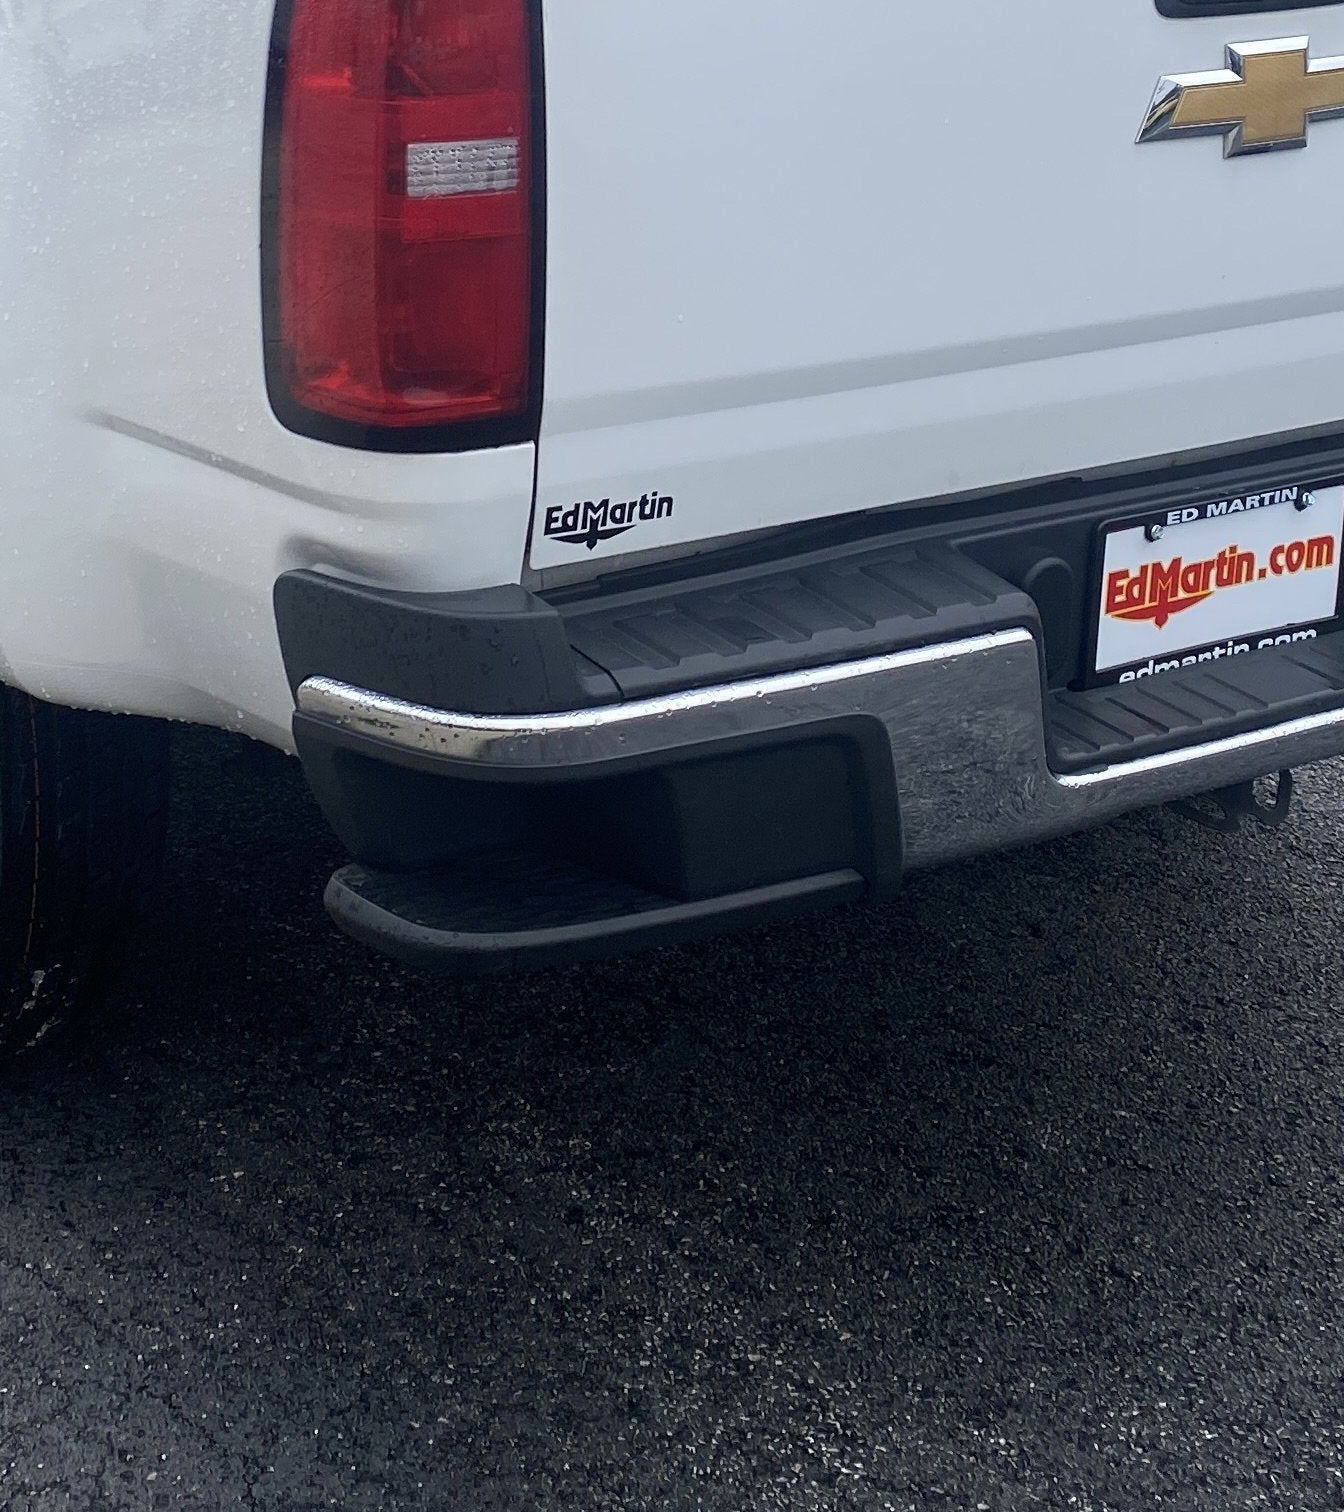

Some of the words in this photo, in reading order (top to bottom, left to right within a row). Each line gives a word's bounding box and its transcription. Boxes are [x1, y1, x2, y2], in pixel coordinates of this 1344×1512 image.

[544, 491, 674, 546] EdMartin
[1166, 508, 1199, 526] ED
[1206, 487, 1298, 518] MARTIN
[1105, 535, 1335, 616] EdMartin.com
